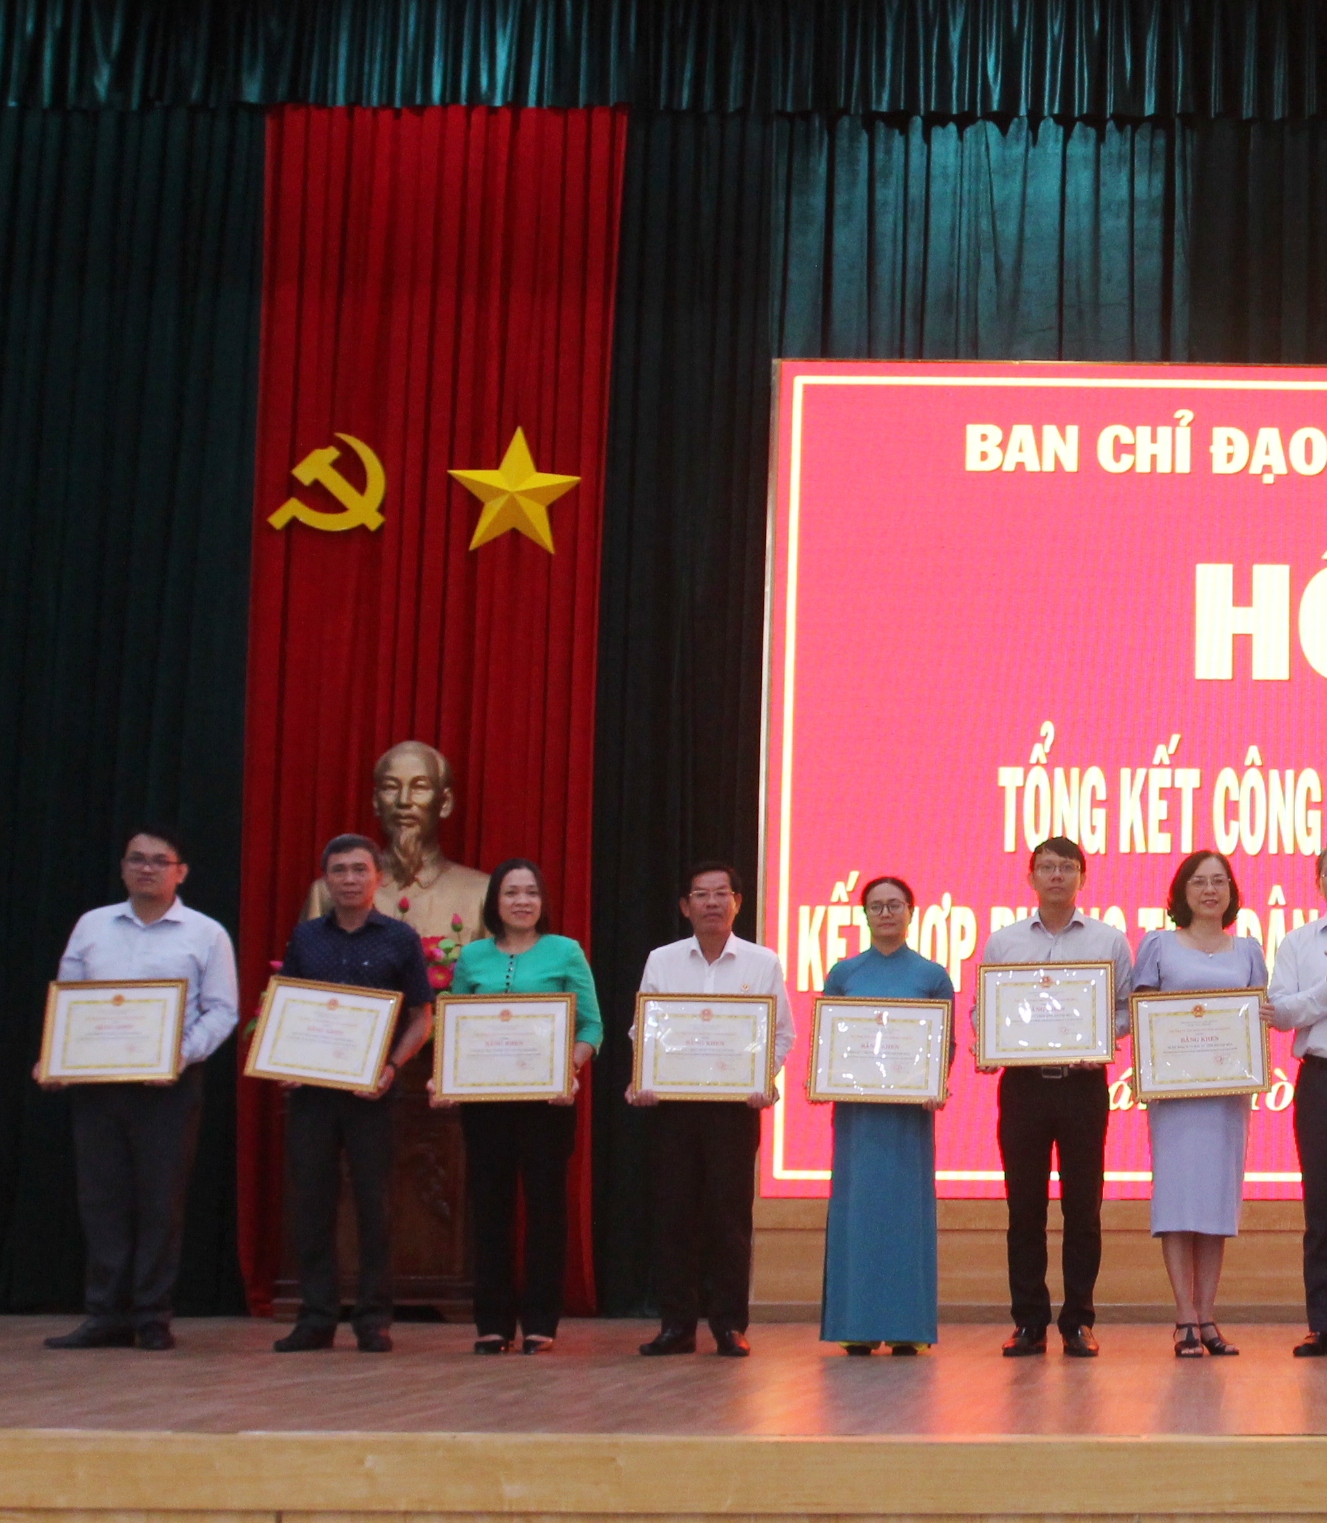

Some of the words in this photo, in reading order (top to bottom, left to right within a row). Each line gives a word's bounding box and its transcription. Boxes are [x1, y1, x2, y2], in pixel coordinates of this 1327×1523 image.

[966, 424, 1079, 473] BAN
[1097, 409, 1195, 474] CHỈ
[998, 721, 1107, 854] TỔNG
[1119, 734, 1201, 854] KẾT
[1213, 745, 1322, 856] CÔNG
